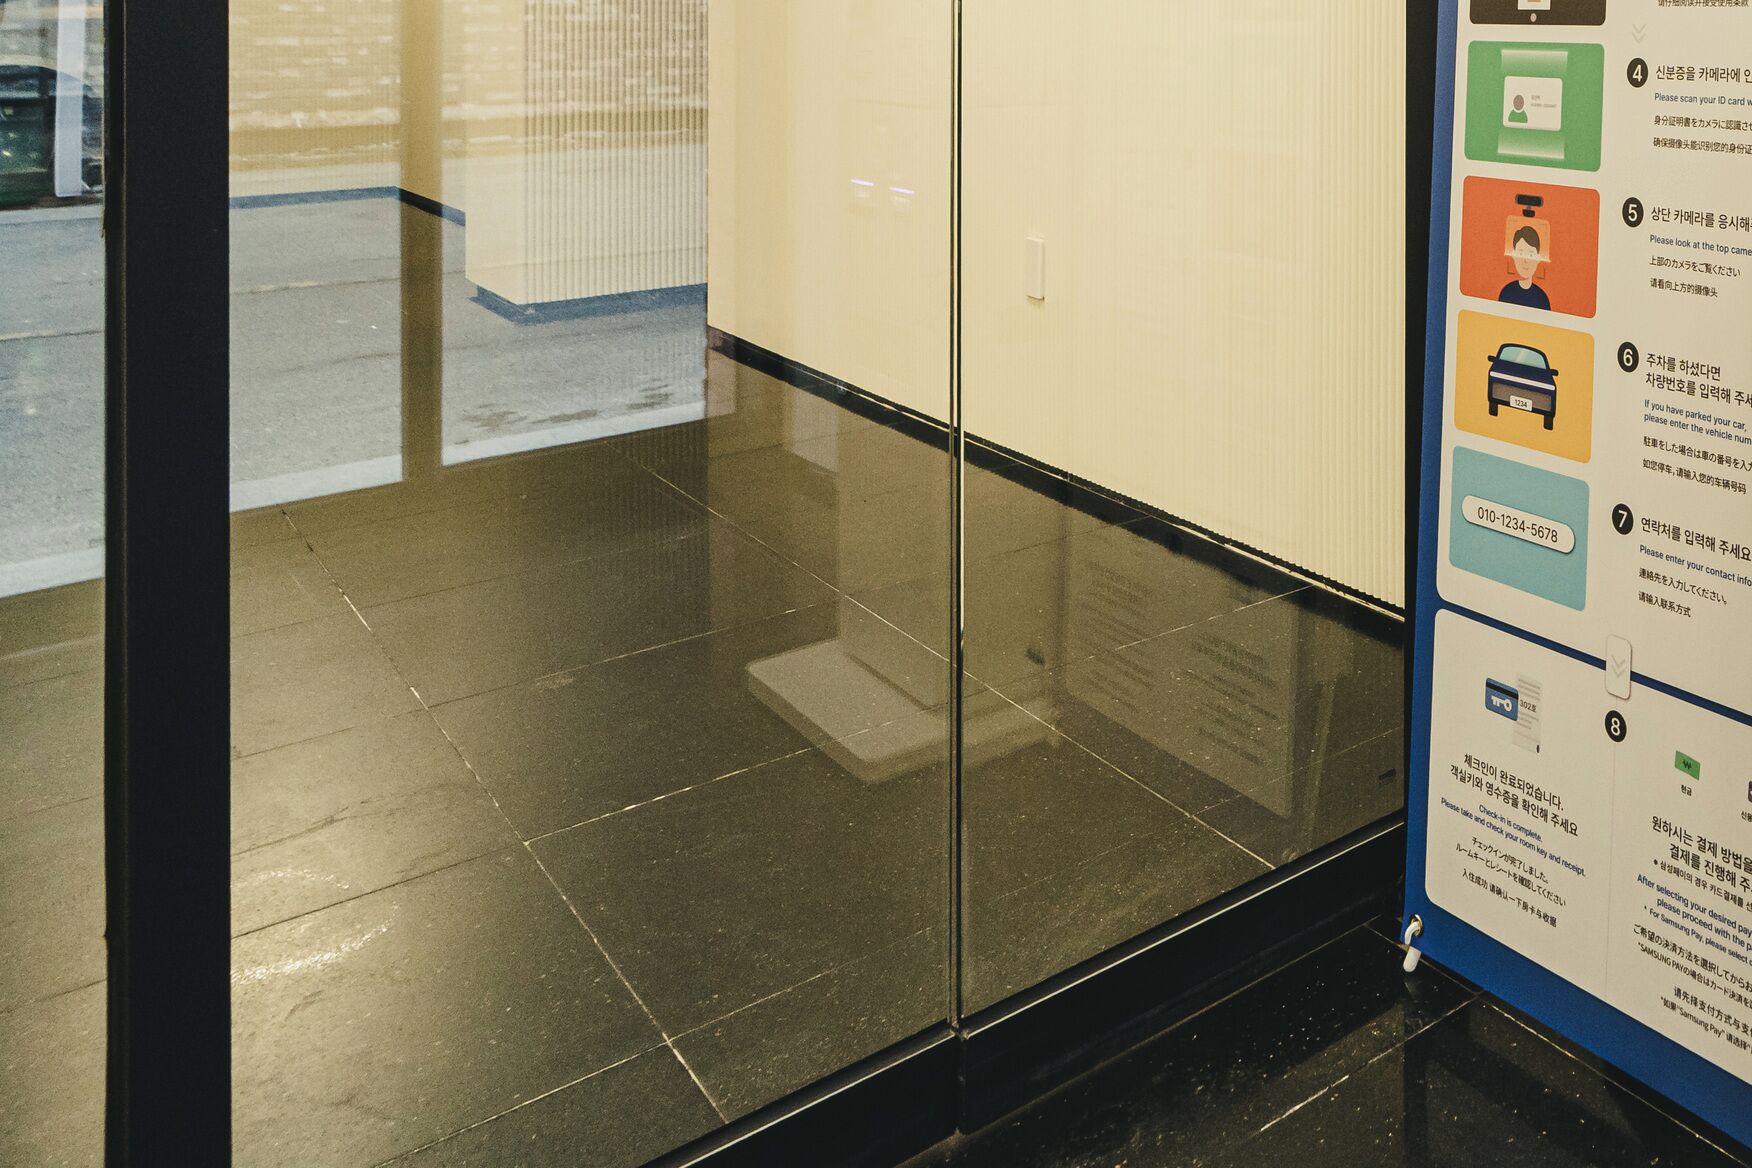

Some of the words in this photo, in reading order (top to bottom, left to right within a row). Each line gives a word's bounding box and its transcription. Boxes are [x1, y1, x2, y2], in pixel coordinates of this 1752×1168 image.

[1633, 64, 1642, 81] 4
[1656, 65, 1695, 81] 신분증을
[1699, 67, 1741, 83] 카메라에
[1628, 204, 1638, 221] 5
[1651, 207, 1671, 222] 상단
[1673, 209, 1715, 228] 카메라를
[1650, 234, 1674, 245] Please
[1675, 238, 1691, 248] look
[1693, 241, 1700, 249] at
[1702, 242, 1714, 251] the
[1716, 244, 1729, 254] top
[1623, 349, 1633, 367] 6
[1646, 353, 1676, 372] 주차를
[1679, 359, 1721, 381] 하셨다면
[1645, 372, 1696, 396] 차량번호를
[1699, 383, 1731, 404] 입력해
[1477, 506, 1558, 543] 010-1234-5678
[1618, 510, 1627, 527] 7
[1640, 516, 1682, 543] 연락처를
[1684, 528, 1716, 551] 입력해
[1718, 538, 1751, 562] 주세요
[1520, 699, 1537, 713] 302호
[1610, 717, 1620, 736] 8
[1464, 753, 1497, 781] 체크인이
[1500, 769, 1564, 811] 완료되었습니다.
[1680, 784, 1692, 797] 현금
[1450, 765, 1483, 791] 객실키와
[1486, 781, 1519, 809] 영수증을
[1522, 798, 1548, 823] 확인해
[1551, 813, 1578, 837] 주세요
[1652, 815, 1693, 846] 원하시는
[1697, 835, 1718, 859] 결제
[1669, 843, 1701, 871] 결제를
[1704, 859, 1736, 888] 진행해
